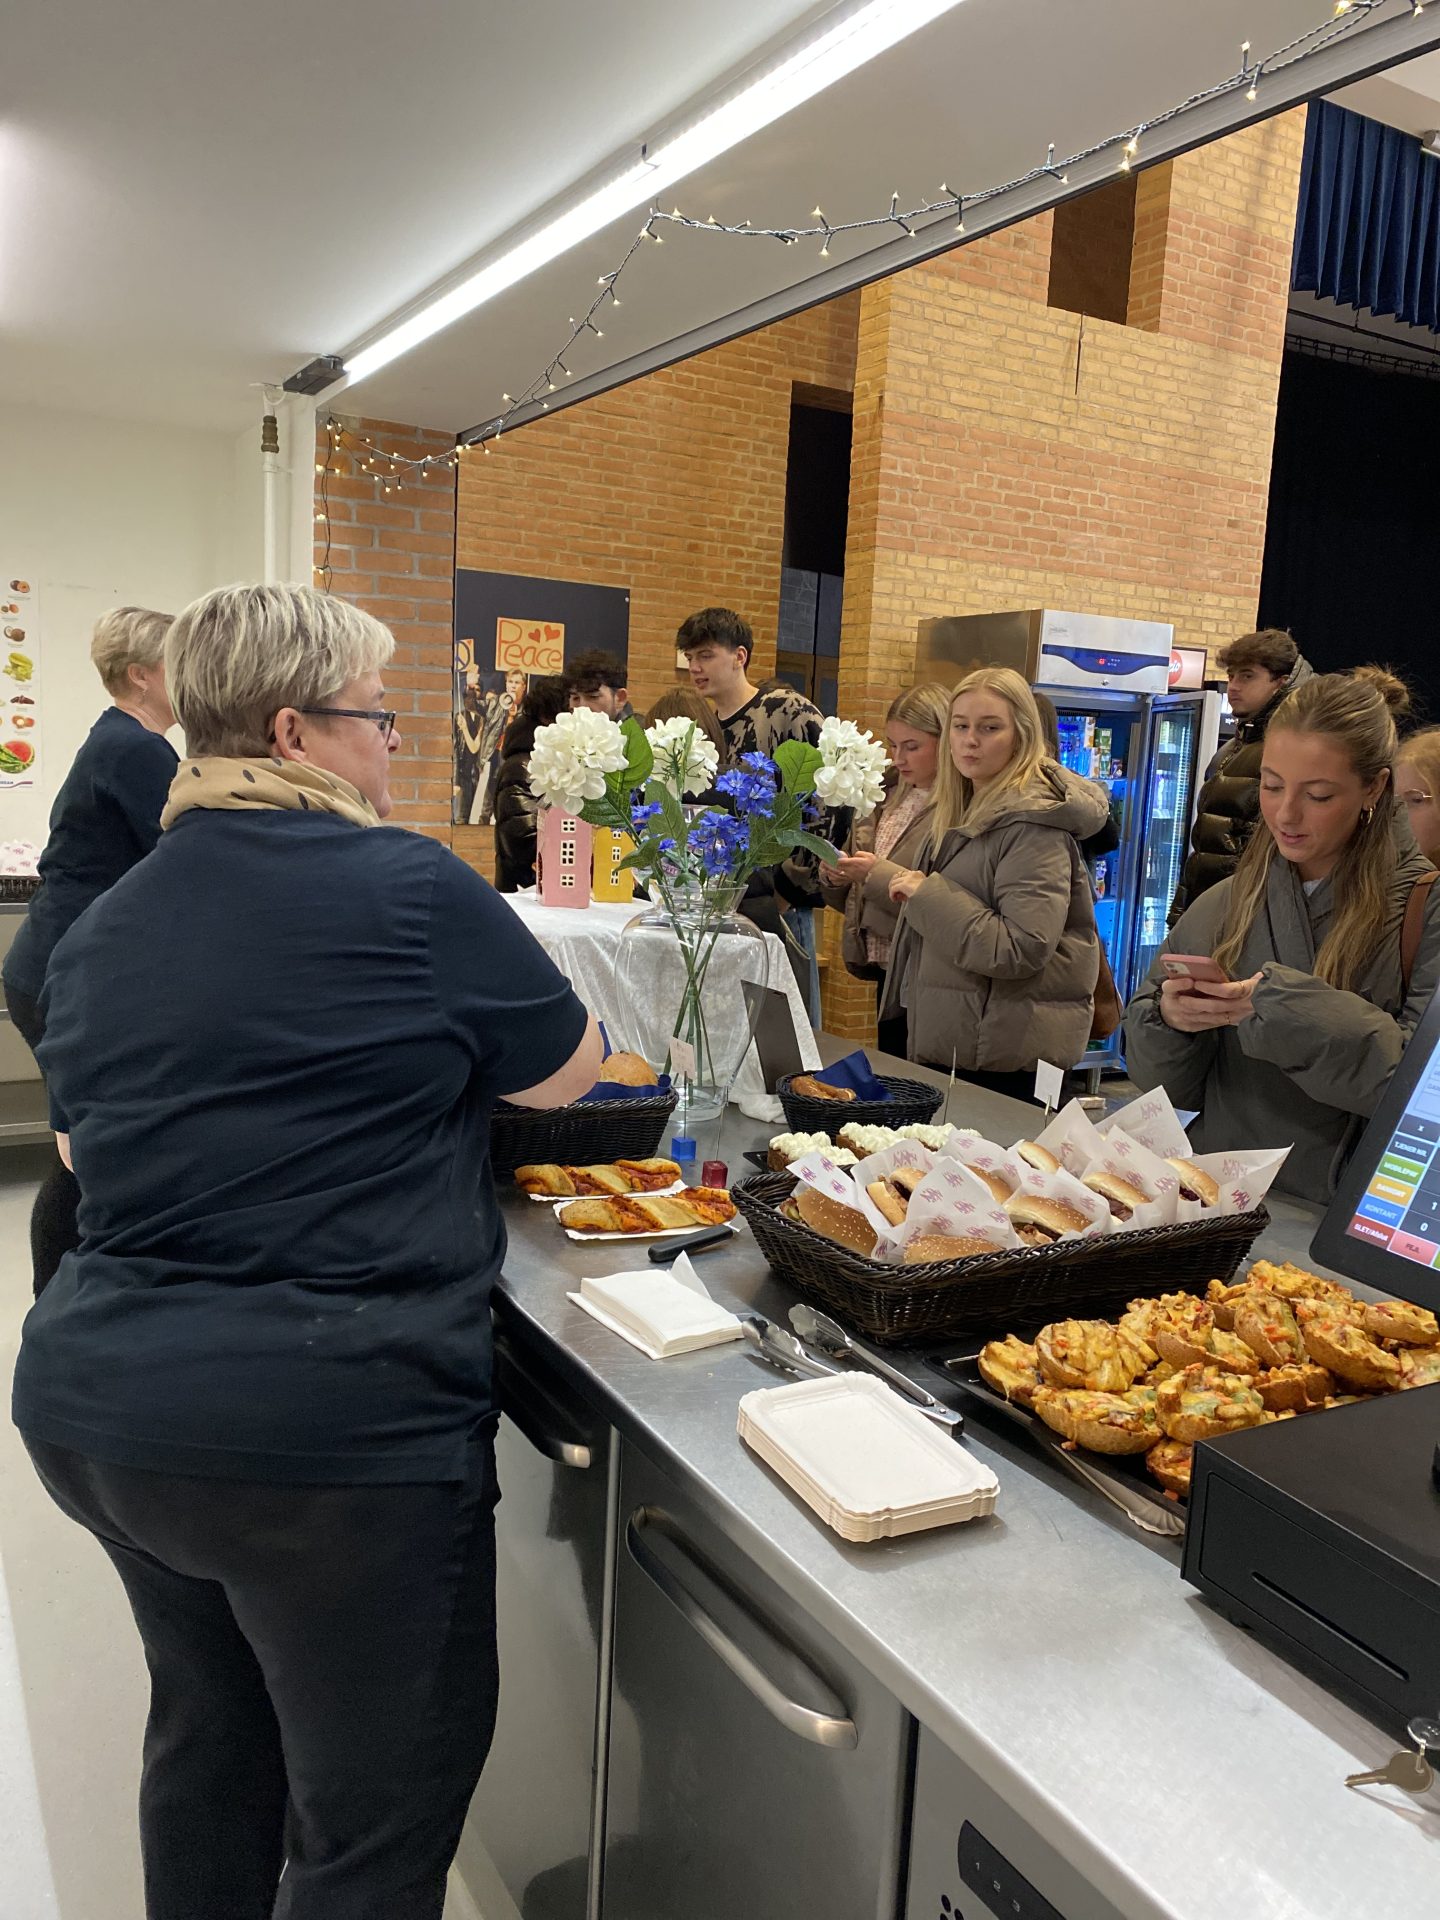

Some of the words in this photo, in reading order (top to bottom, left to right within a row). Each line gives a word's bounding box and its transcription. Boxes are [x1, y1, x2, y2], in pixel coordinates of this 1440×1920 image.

[498, 620, 562, 669] Peace
[1364, 1203, 1398, 1220] KONTANT
[1420, 1222, 1429, 1232] 0
[975, 1862, 981, 1871] 1
[993, 1880, 1001, 1893] 2
